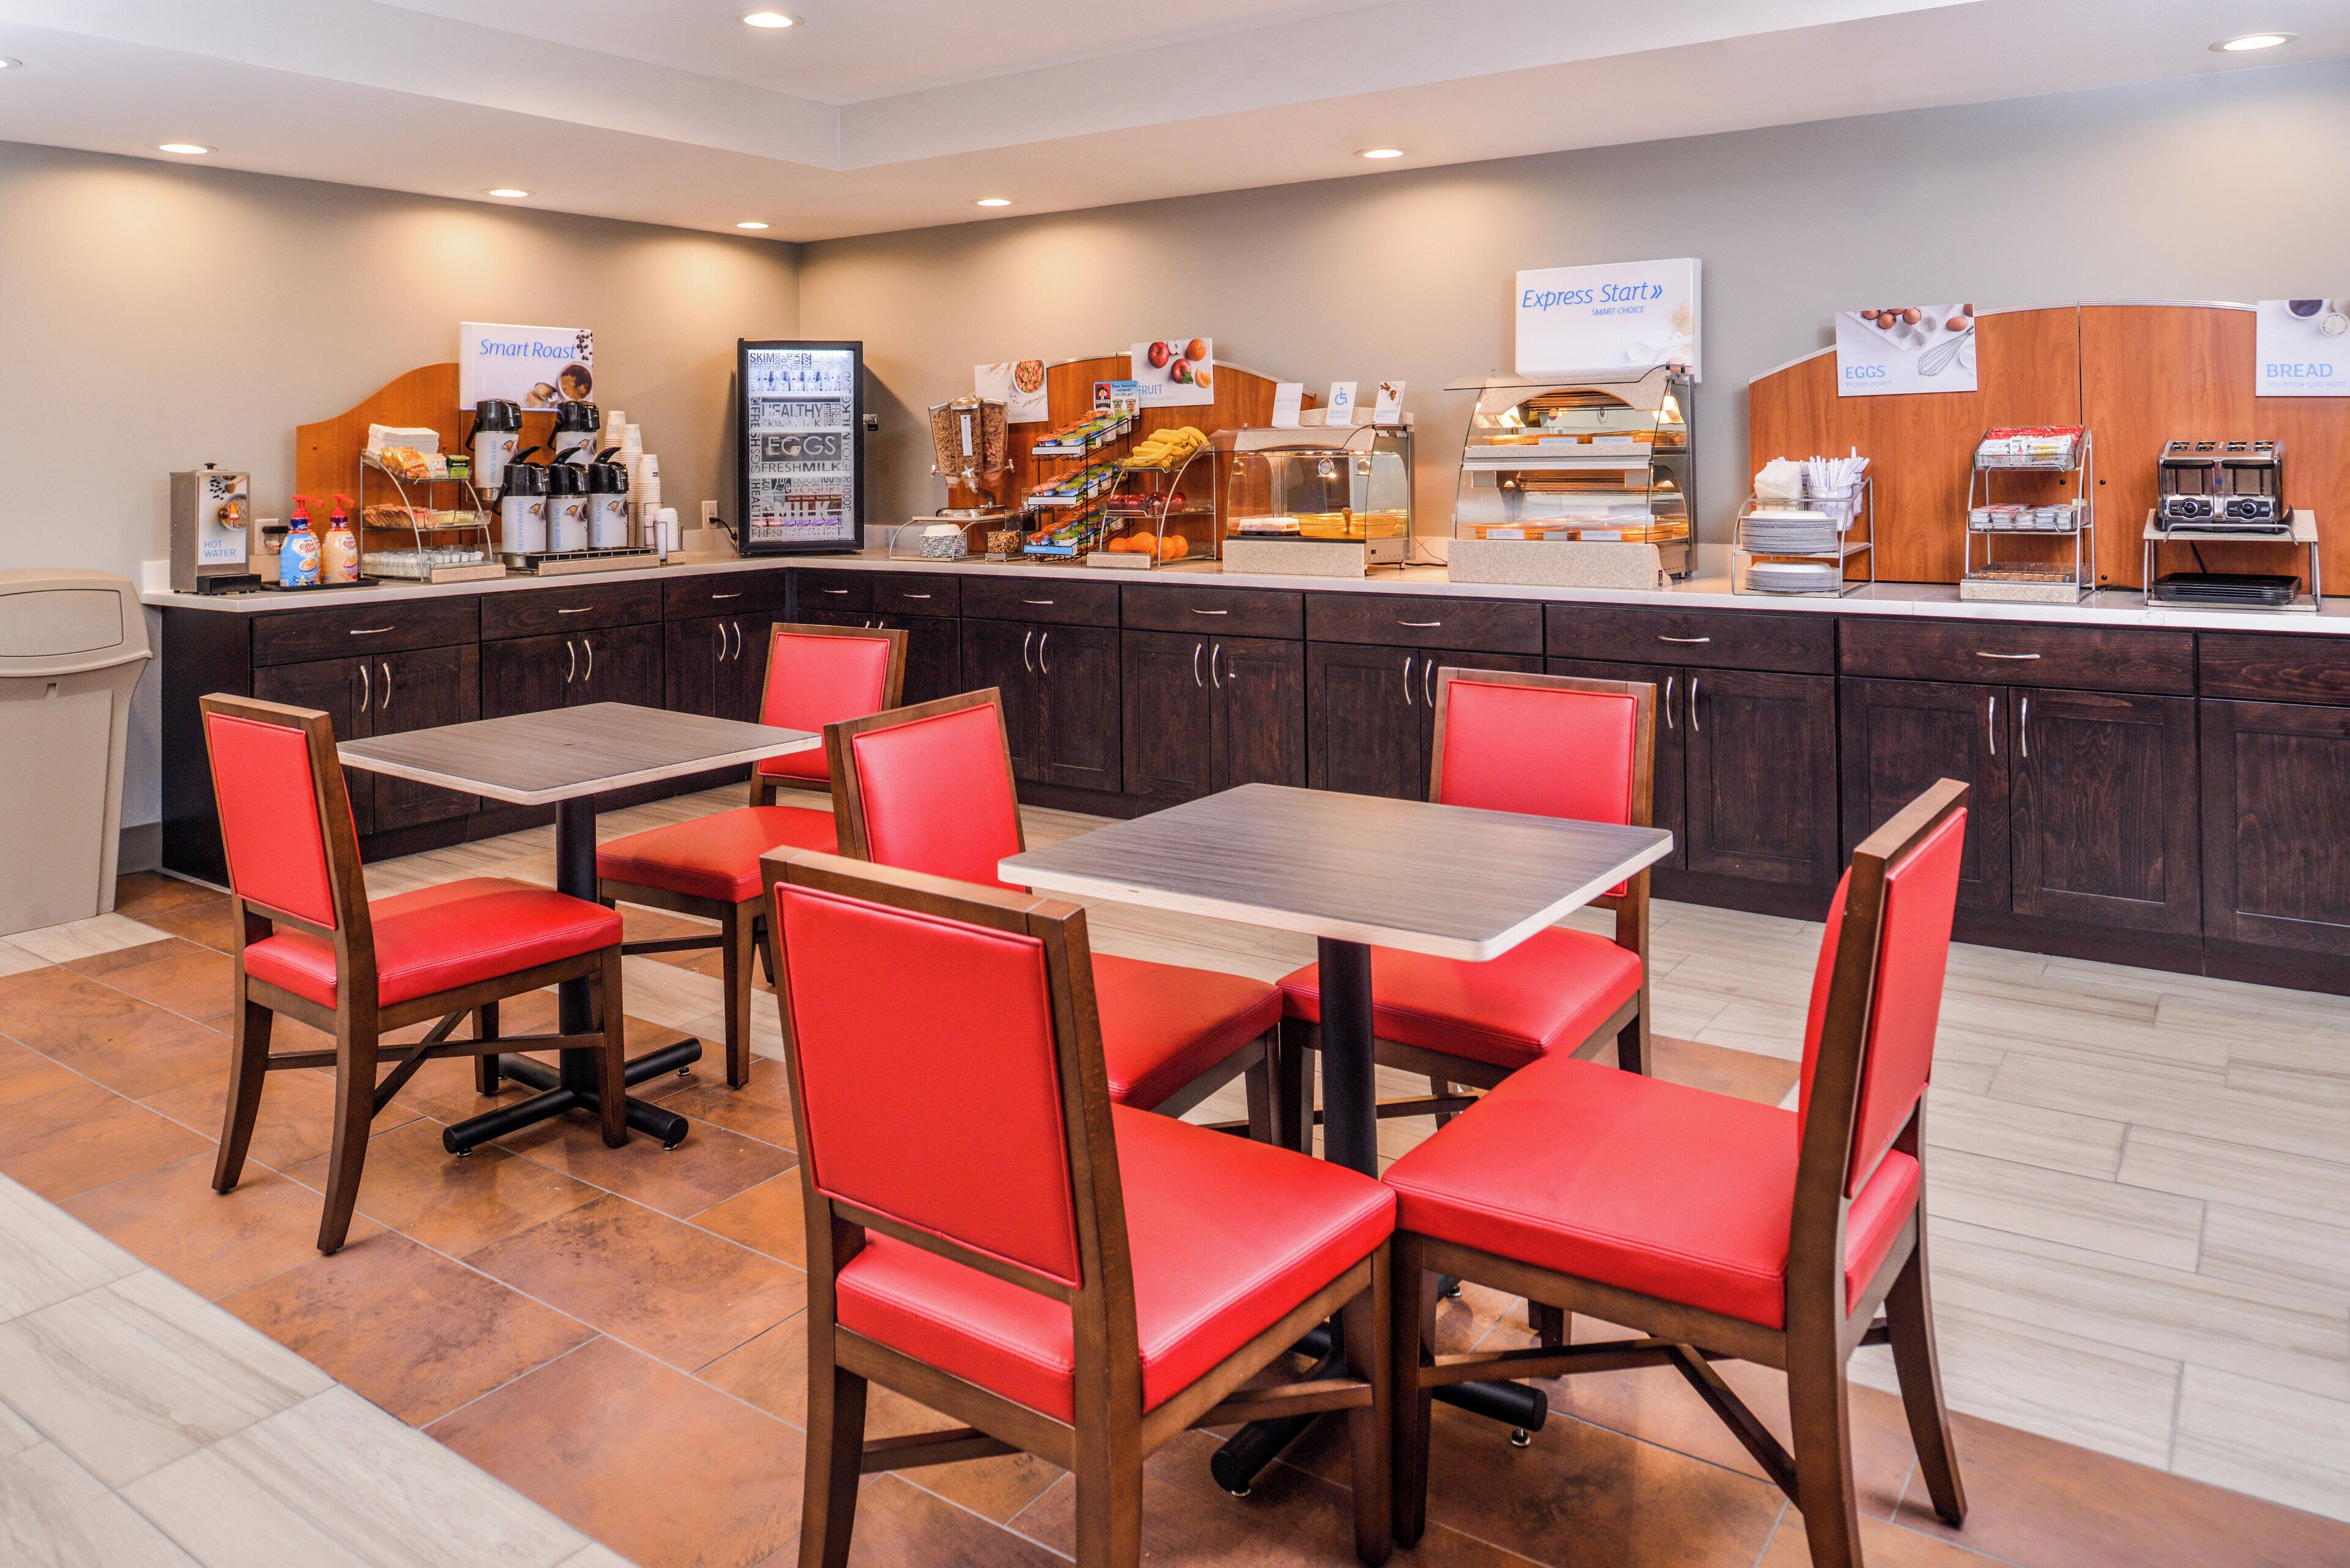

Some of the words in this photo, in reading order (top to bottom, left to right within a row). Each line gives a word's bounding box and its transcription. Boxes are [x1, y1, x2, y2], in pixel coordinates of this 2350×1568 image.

[1523, 289, 1594, 311] Express
[1600, 282, 1648, 302] Start
[1591, 307, 1616, 316] SMART
[1617, 305, 1645, 314] CHOICE
[480, 339, 529, 357] Smart
[532, 342, 576, 359] Roast
[750, 353, 774, 362] SKIM
[781, 353, 793, 370] 2%
[1846, 365, 1885, 378] EGGS
[2266, 364, 2333, 377] BREAD
[1871, 379, 1892, 388] power!
[763, 404, 823, 417] HEALTHY
[768, 436, 835, 455] EGGS
[762, 463, 800, 472] FRESH
[803, 462, 841, 472] MILK
[774, 501, 830, 520] MILK
